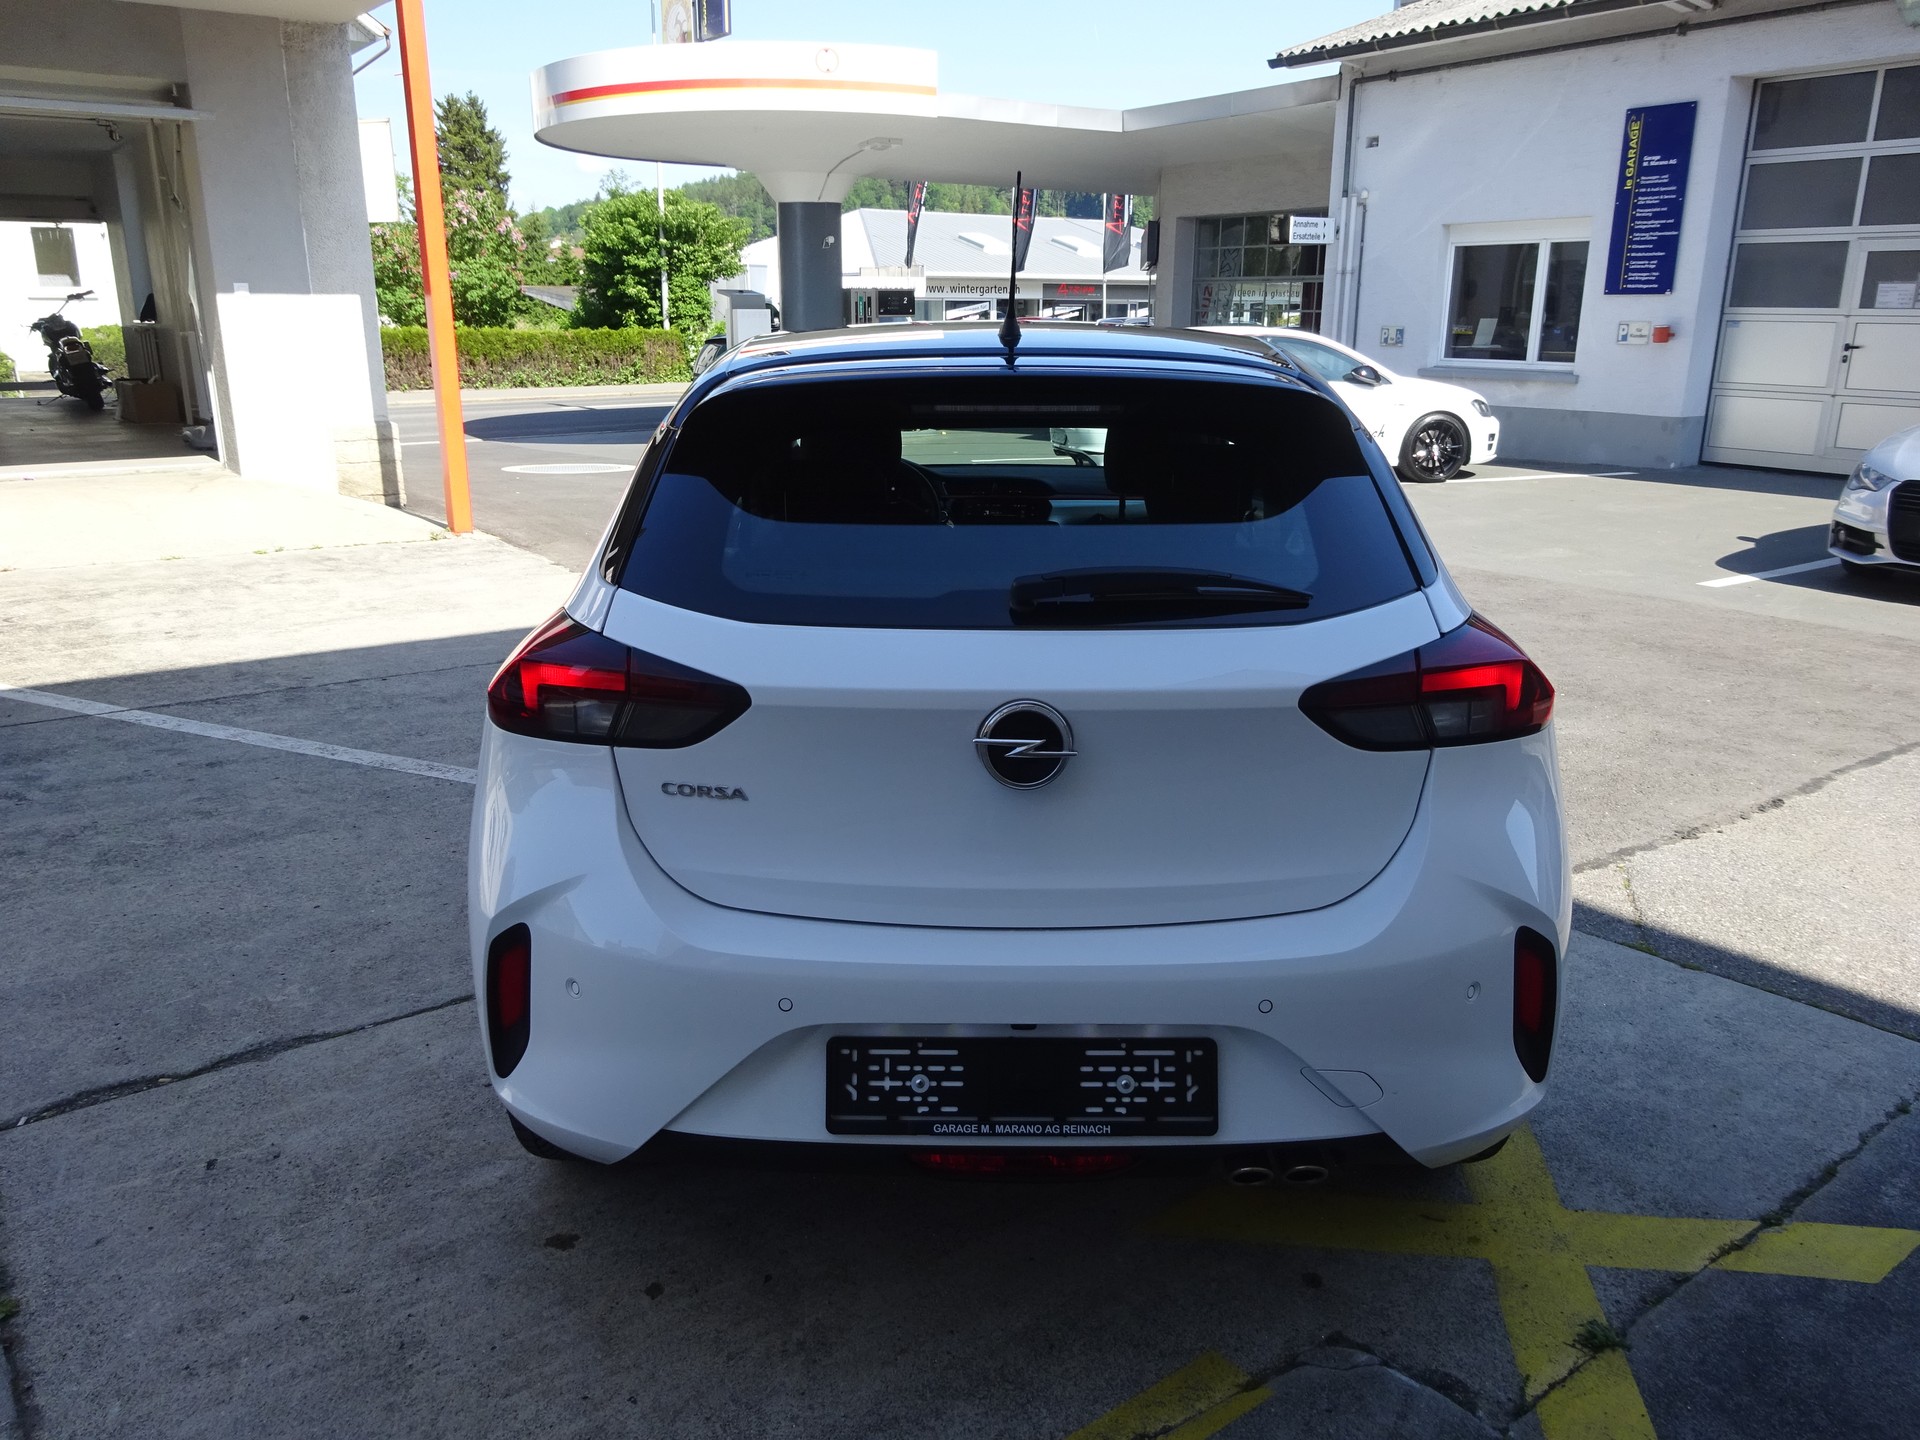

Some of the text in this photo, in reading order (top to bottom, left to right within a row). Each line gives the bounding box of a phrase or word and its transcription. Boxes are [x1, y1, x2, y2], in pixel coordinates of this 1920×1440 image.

[1624, 120, 1640, 190] le GARAGE
[1012, 188, 1030, 232] ATRI
[1105, 194, 1124, 235] ATRI
[1292, 220, 1319, 229] Annahme
[1292, 232, 1321, 241] Ersatzteile
[925, 282, 1020, 297] ww.wintergarten.h
[661, 782, 749, 801] CORSA
[933, 1123, 1111, 1134] GARAGE M. MARANO AG REINACH
